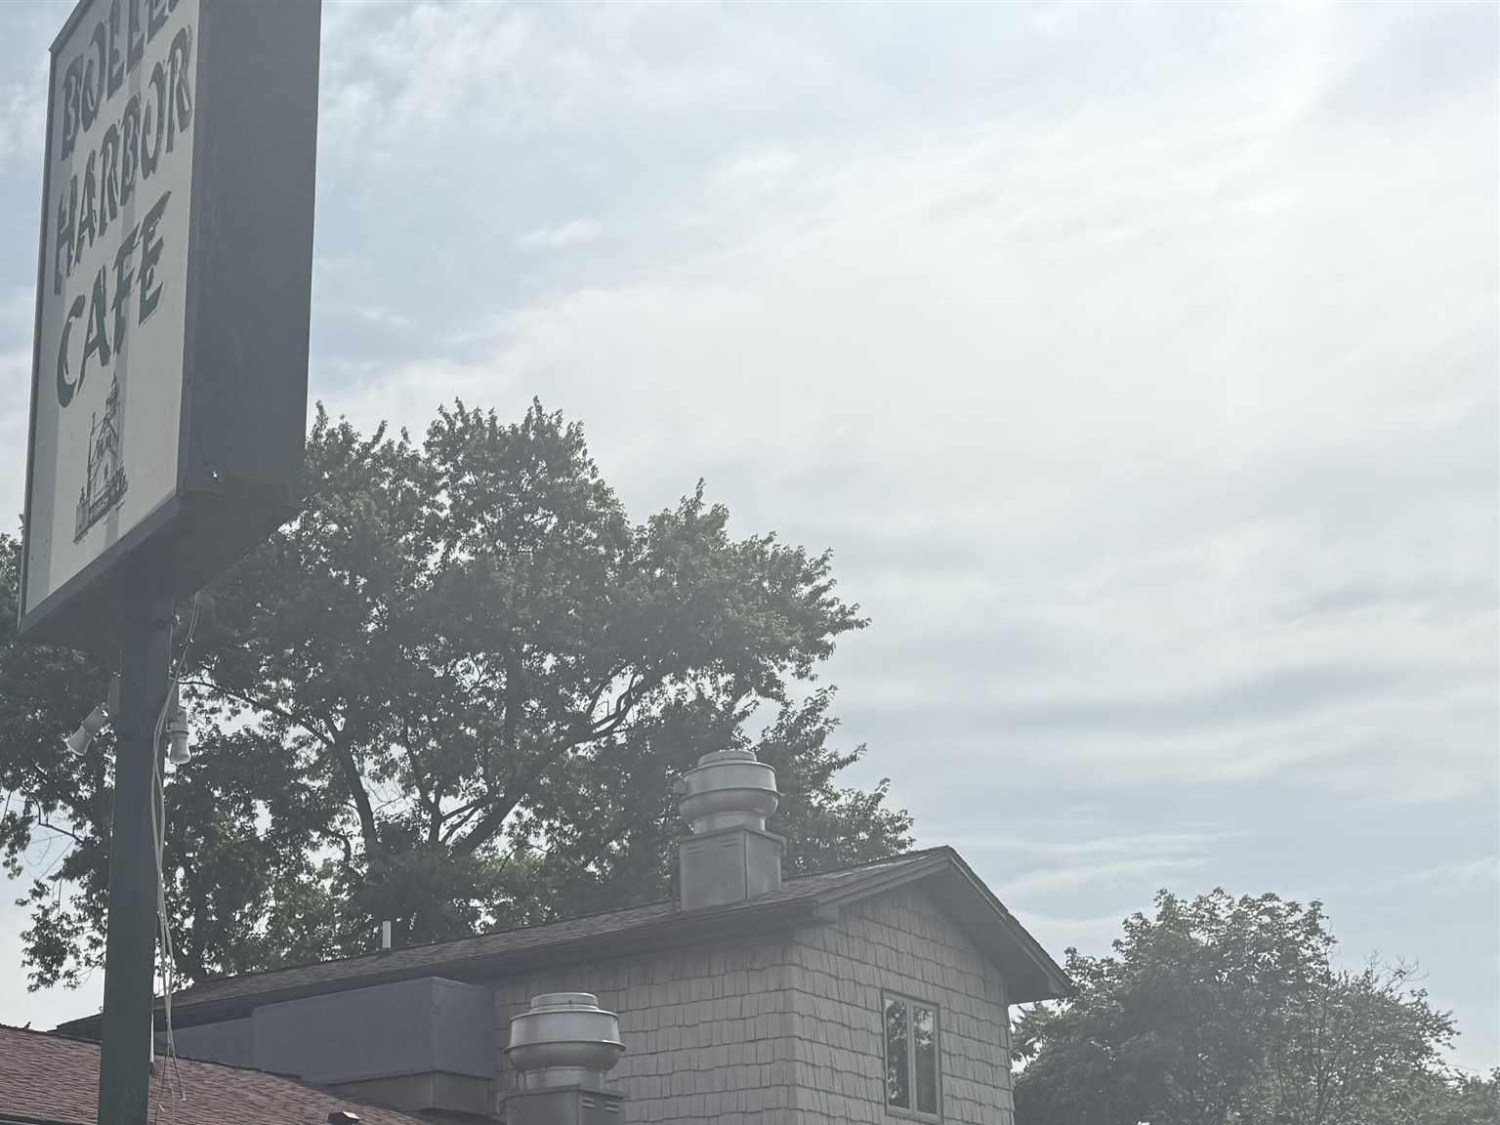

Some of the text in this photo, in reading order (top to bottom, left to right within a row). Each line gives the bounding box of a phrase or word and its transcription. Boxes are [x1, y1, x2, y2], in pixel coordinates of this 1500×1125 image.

[55, 25, 192, 295] HARBOR
[61, 0, 177, 161] BOLL
[57, 191, 172, 408] CAFE
